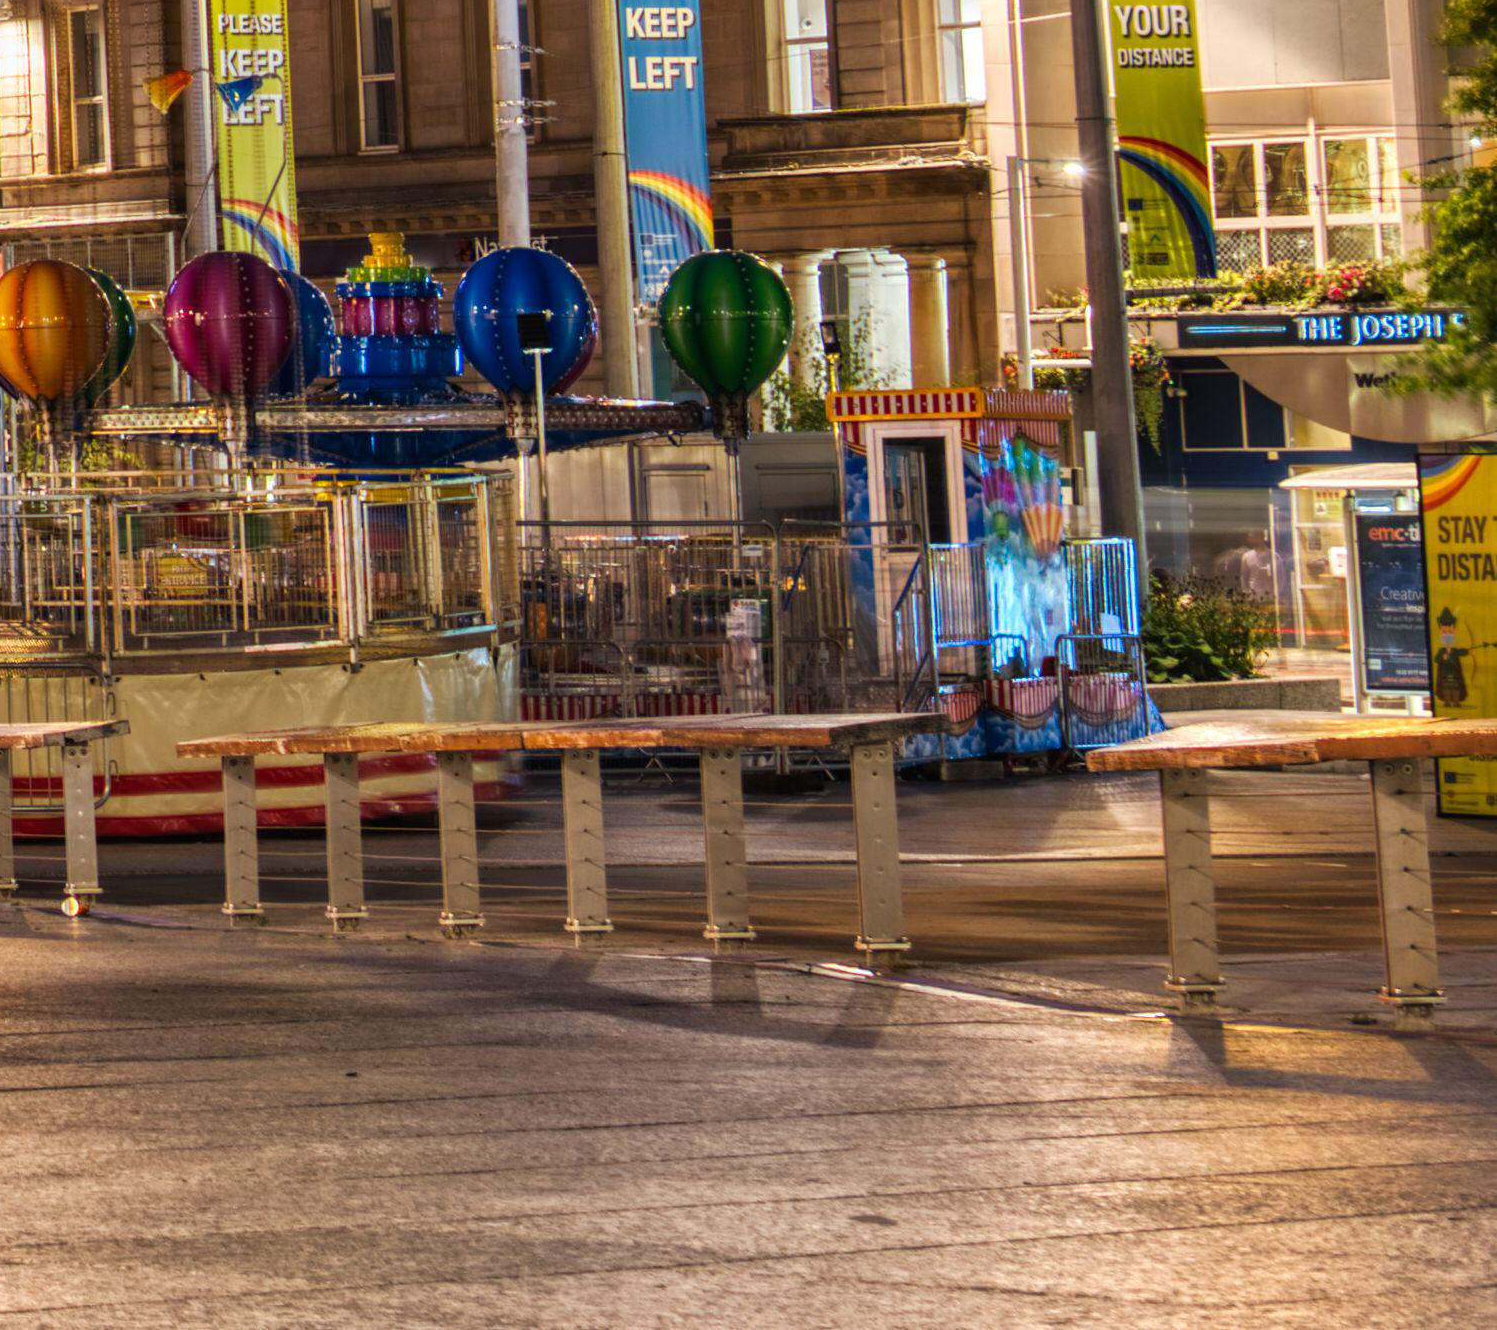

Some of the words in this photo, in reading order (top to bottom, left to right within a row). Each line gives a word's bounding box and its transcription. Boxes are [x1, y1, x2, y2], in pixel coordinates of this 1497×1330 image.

[217, 13, 285, 35] PLEASE
[626, 7, 696, 39] KEEP
[1114, 5, 1192, 38] YOUR
[219, 48, 285, 78] KEEP
[628, 56, 699, 91] LEFT
[1117, 47, 1196, 68] DISTANCE
[223, 94, 285, 126] LEFT
[1294, 315, 1343, 340] THE
[1351, 314, 1445, 346] JOSEPH
[1437, 516, 1487, 543] STAY
